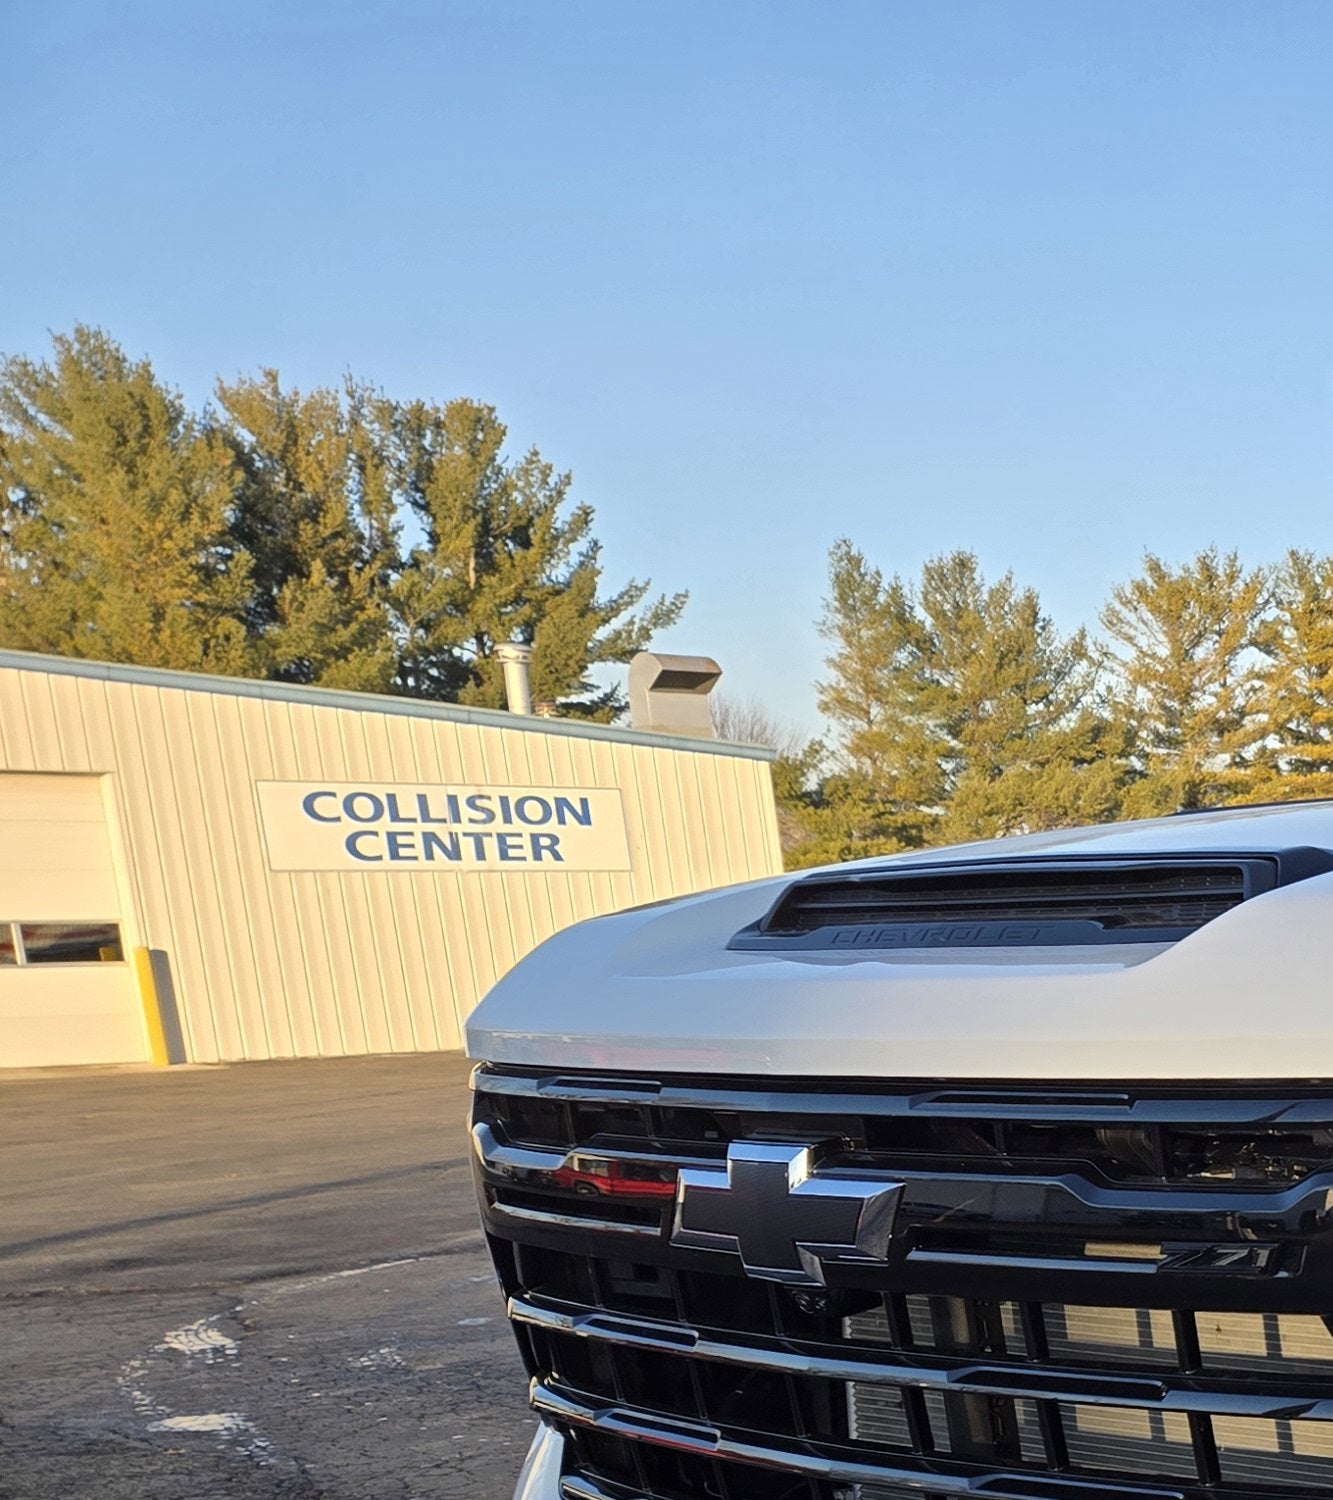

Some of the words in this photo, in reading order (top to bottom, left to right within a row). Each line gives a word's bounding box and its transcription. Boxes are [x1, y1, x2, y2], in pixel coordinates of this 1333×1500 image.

[301, 791, 593, 827] COLLISION
[344, 830, 565, 863] CENTER
[831, 925, 1054, 945] CHEVROLET
[1157, 1241, 1279, 1278] Z71
